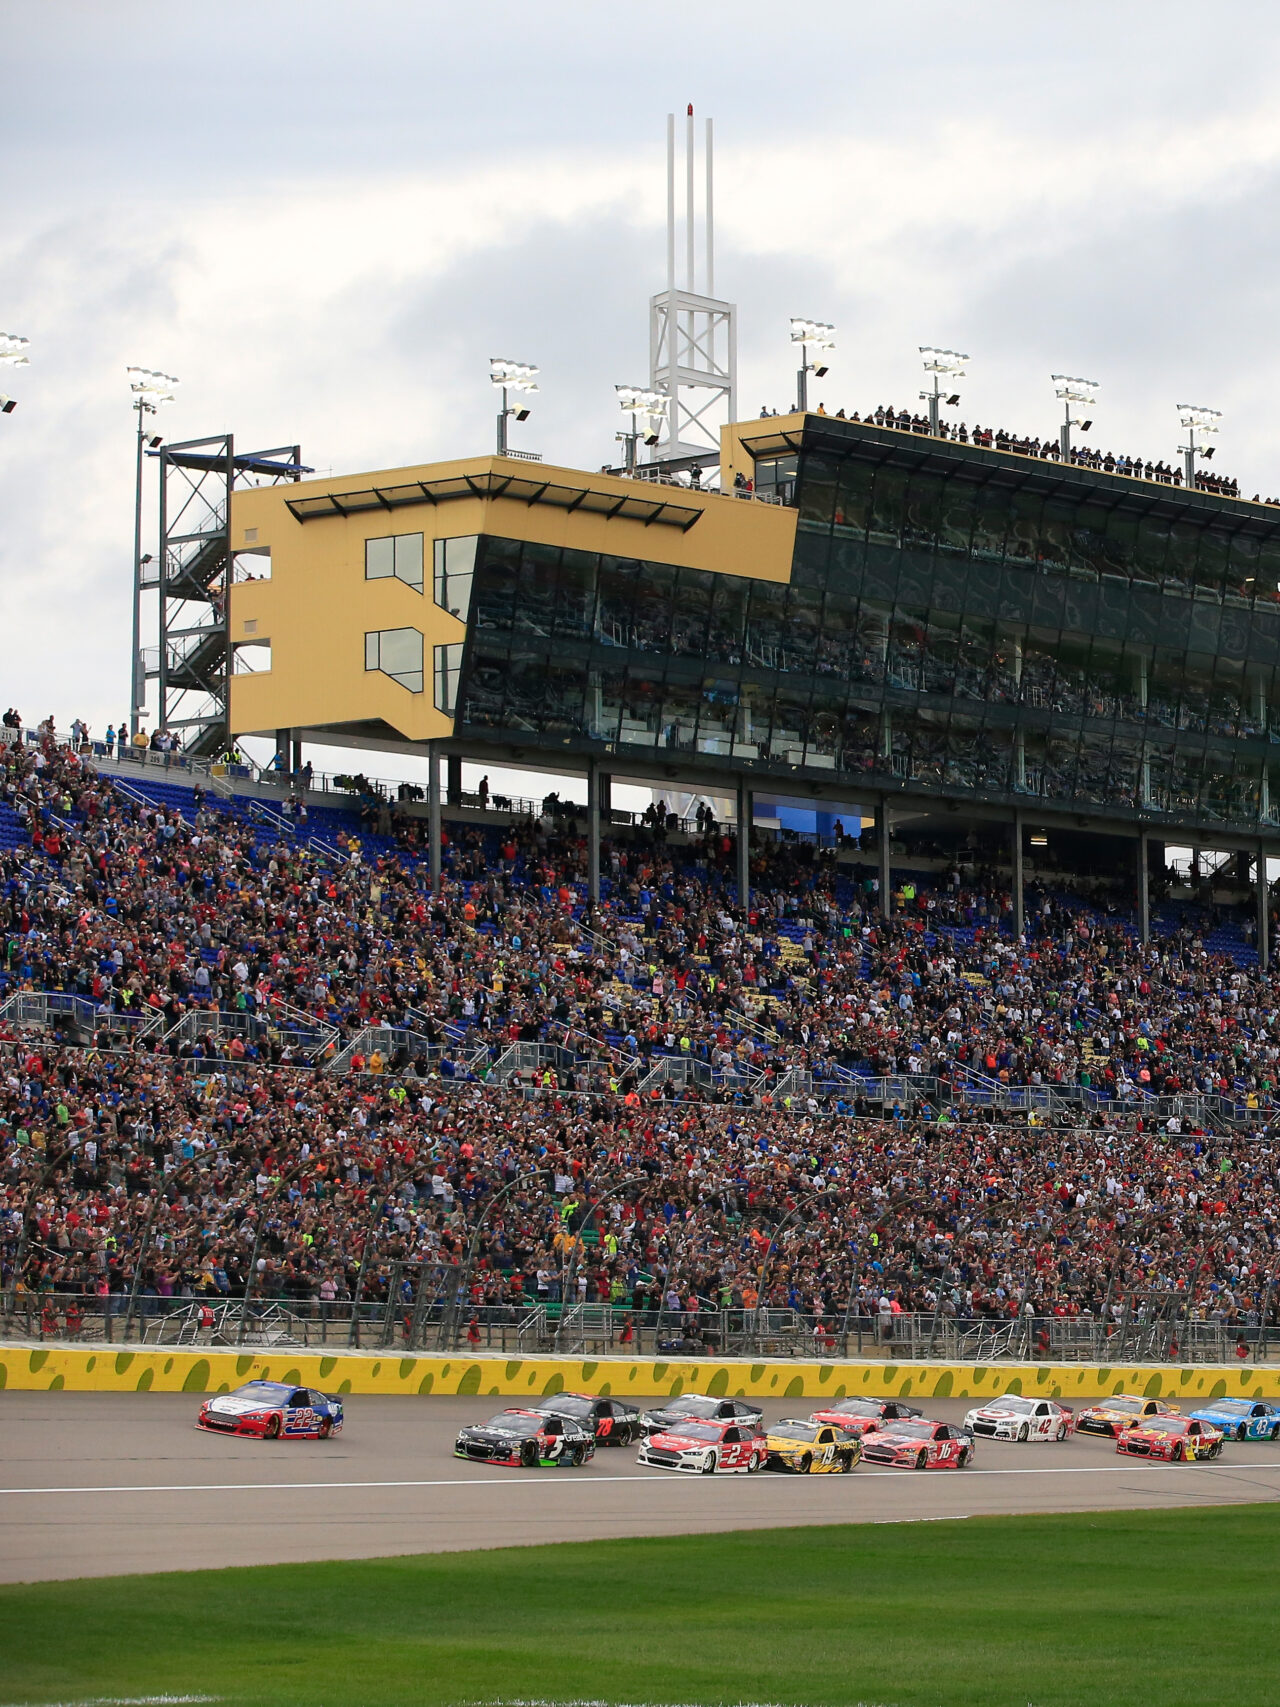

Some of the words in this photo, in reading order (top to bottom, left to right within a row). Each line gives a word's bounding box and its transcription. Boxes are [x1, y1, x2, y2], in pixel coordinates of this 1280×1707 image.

[292, 1407, 314, 1430] 22
[596, 1417, 614, 1437] 78
[1038, 1418, 1052, 1434] 42
[1256, 1419, 1268, 1434] 43
[549, 1435, 564, 1458] 5
[727, 1444, 741, 1464] 2
[821, 1445, 835, 1465] 19
[938, 1443, 951, 1460] 16
